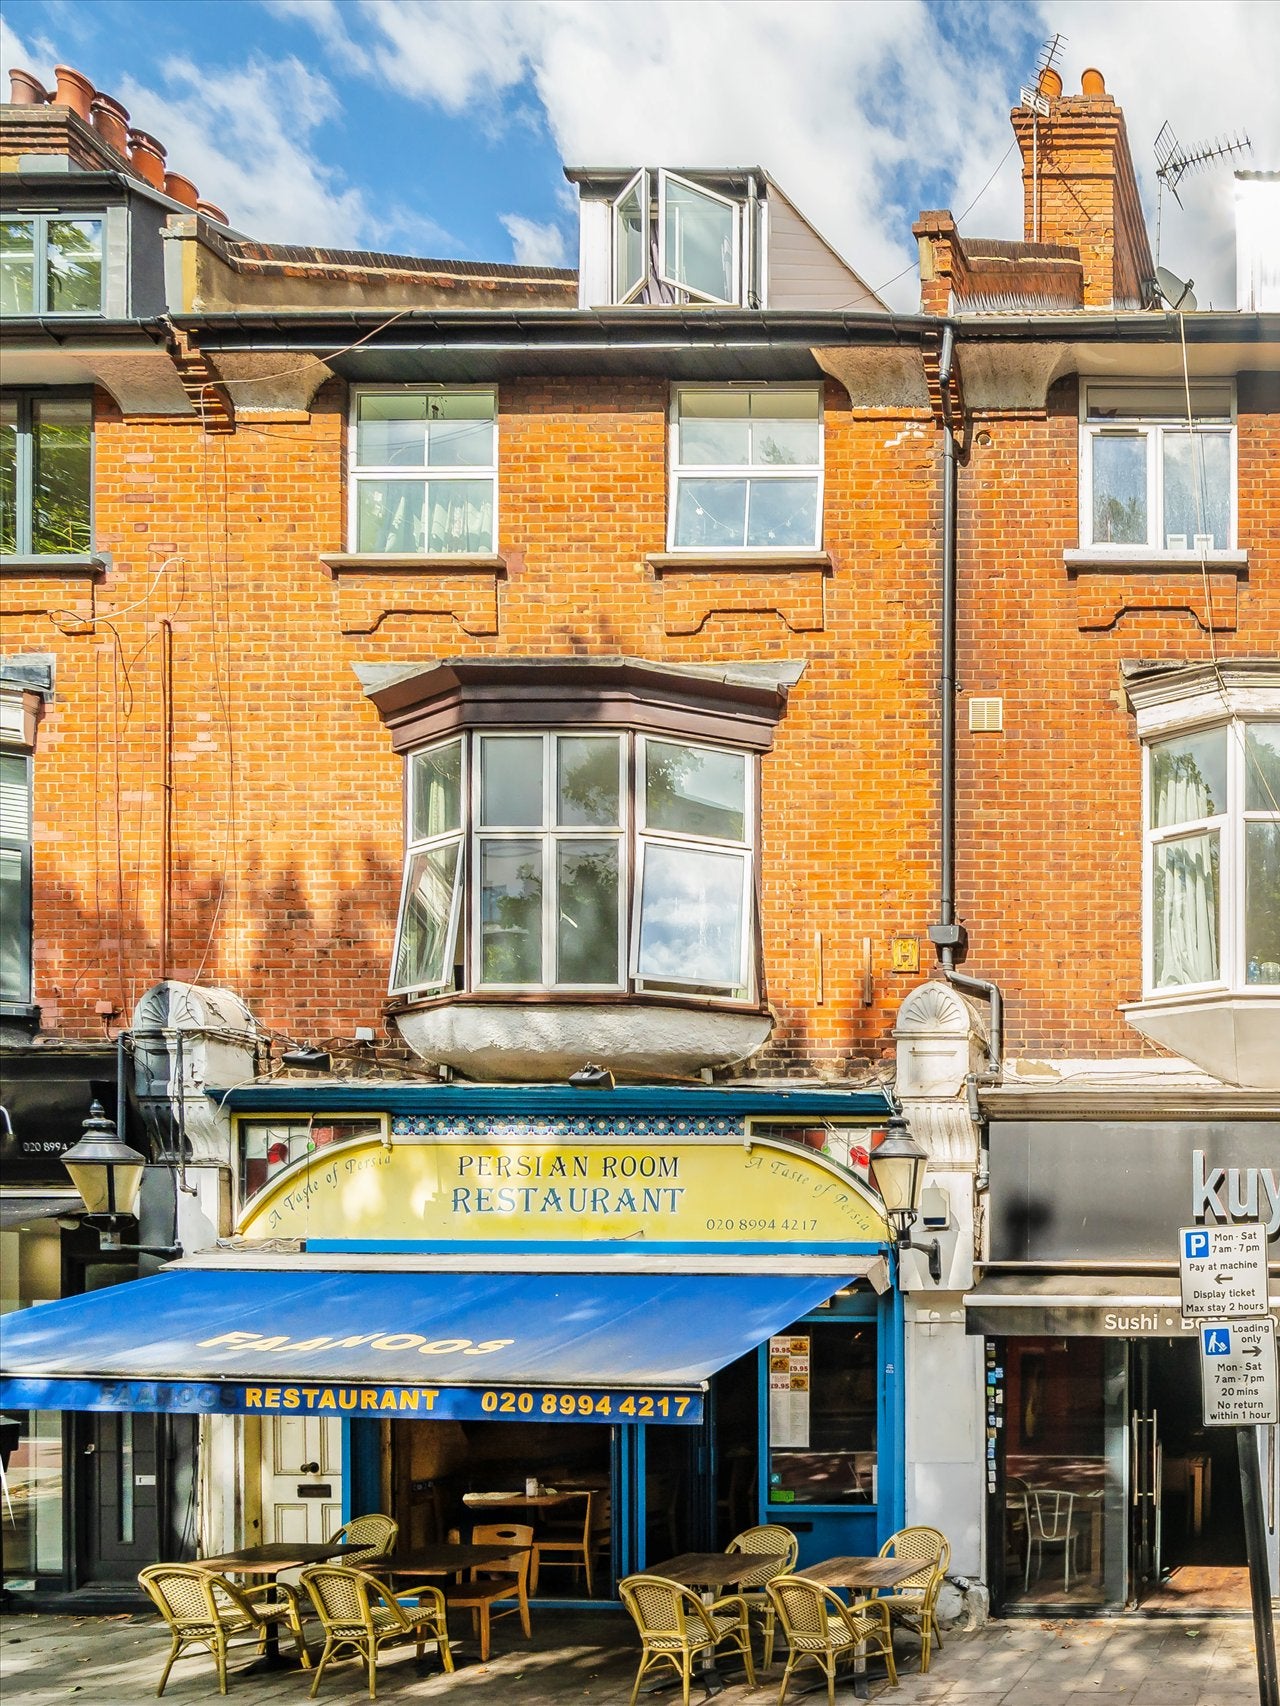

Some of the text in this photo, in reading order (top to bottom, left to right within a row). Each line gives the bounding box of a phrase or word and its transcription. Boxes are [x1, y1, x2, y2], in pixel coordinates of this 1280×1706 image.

[23, 1142, 41, 1152] 020
[43, 1142, 68, 1152] 8994
[326, 1162, 338, 1188] of
[345, 1151, 391, 1174] Persia
[457, 1155, 680, 1179] PERSIAN ROOM
[771, 1160, 810, 1185] Taste
[812, 1183, 837, 1198] of
[451, 1187, 685, 1214] RESTAURANT
[706, 1219, 818, 1231] 020 8994 4217
[1214, 1233, 1234, 1242] Mon
[1241, 1231, 1257, 1240] Sat
[1190, 1234, 1206, 1256] P
[1189, 1263, 1205, 1272] Pay
[1220, 1260, 1258, 1270] machine
[1193, 1288, 1256, 1300] Display ticket
[1186, 1304, 1205, 1313] Max
[1207, 1303, 1226, 1312] stay
[1238, 1302, 1264, 1310] hours
[1104, 1313, 1158, 1331] Sushi
[1232, 1324, 1269, 1333] Loading
[197, 1330, 516, 1356] FAANOOS
[1241, 1334, 1261, 1344] only
[1217, 1363, 1238, 1372] Mon
[1245, 1362, 1262, 1371] Sat
[1221, 1387, 1259, 1396] 20 mins
[245, 1387, 440, 1412] RESTAURANT
[481, 1391, 534, 1414] 020
[540, 1393, 612, 1416] 8994
[619, 1395, 691, 1418] 4217
[1217, 1401, 1264, 1409] No return
[1209, 1412, 1239, 1420] within
[1249, 1411, 1271, 1419] hour
